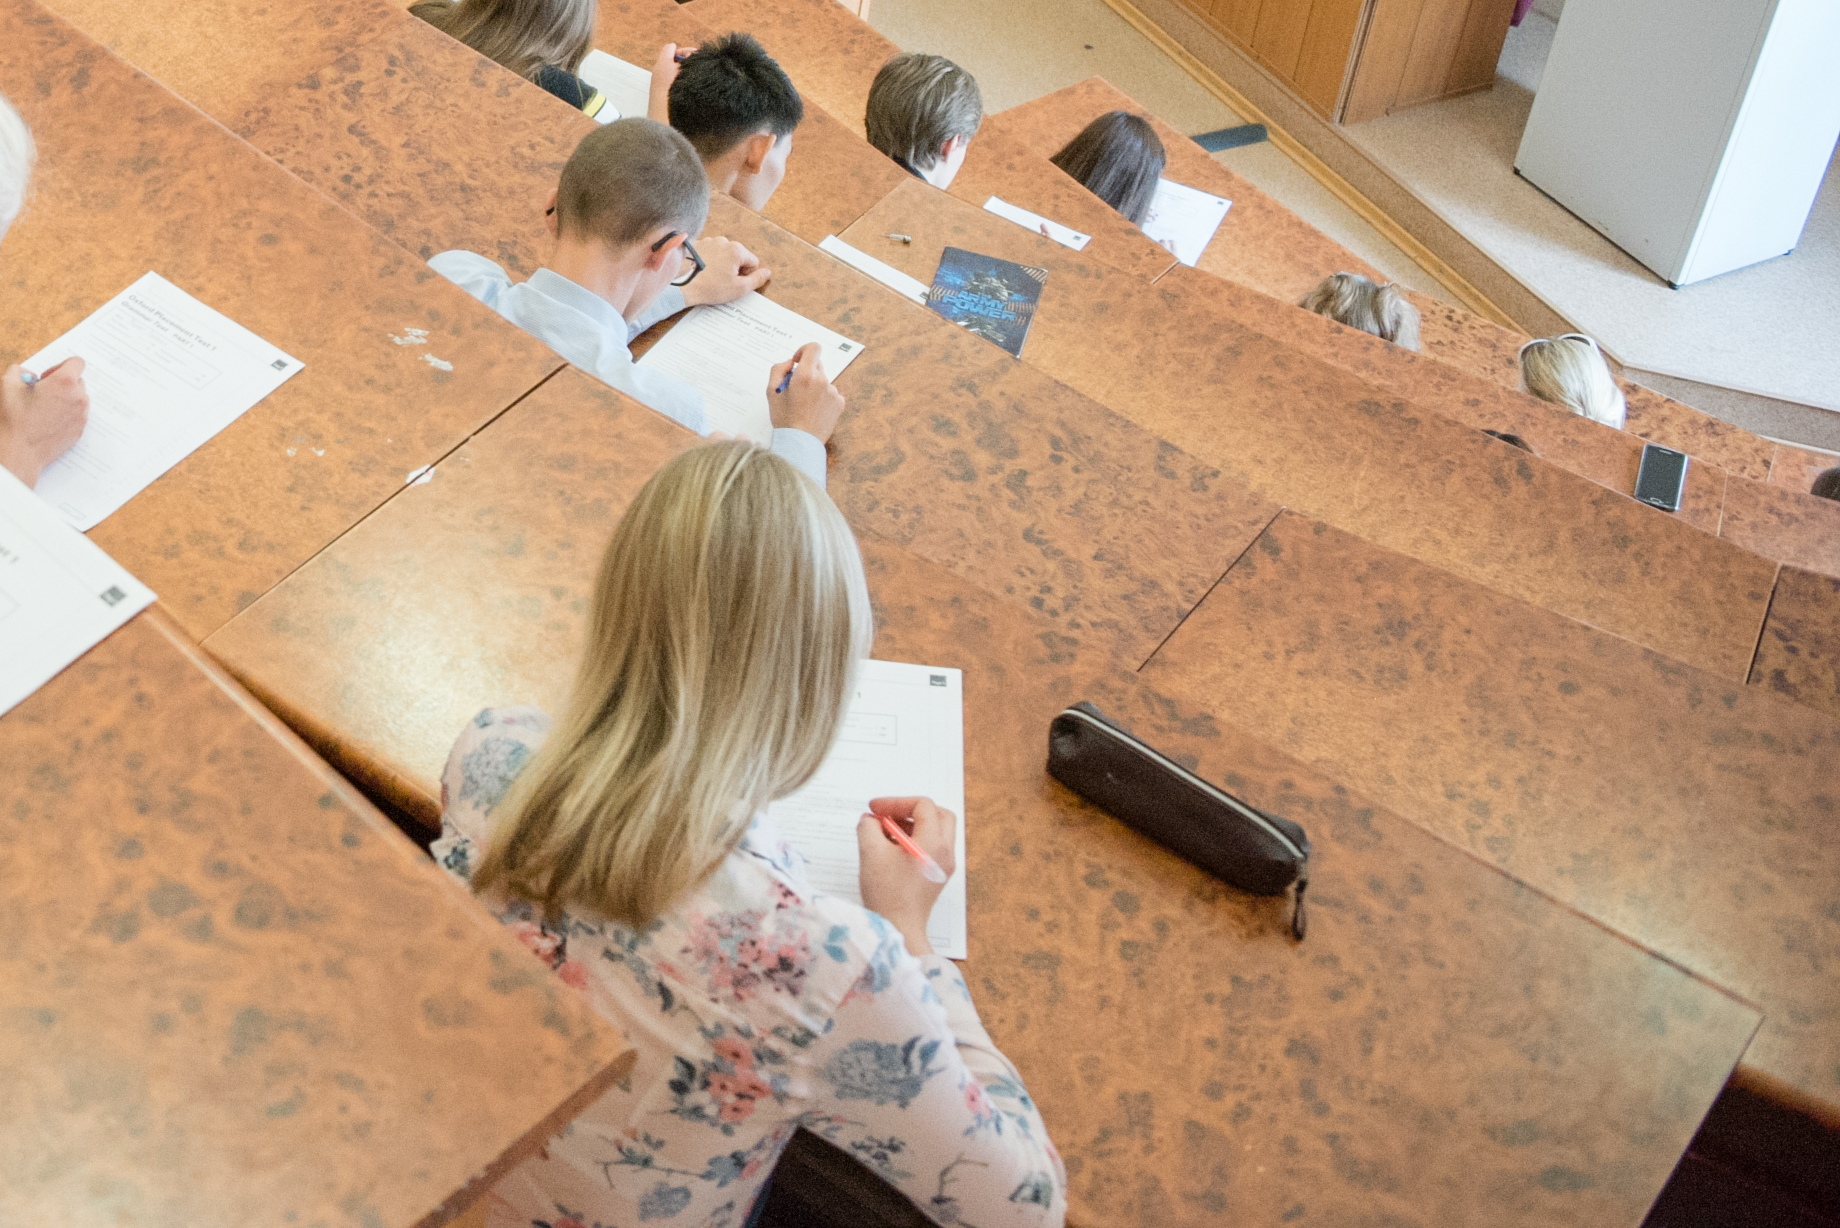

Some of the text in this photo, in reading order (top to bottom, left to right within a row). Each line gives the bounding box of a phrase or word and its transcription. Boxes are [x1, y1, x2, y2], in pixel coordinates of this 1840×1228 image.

[942, 293, 1017, 321] POWER
[957, 290, 1007, 310] ARMY
[121, 300, 152, 322] Grammar
[153, 320, 169, 333] Test
[172, 333, 189, 345] PART
[128, 294, 155, 314] Oxford
[153, 310, 194, 338] Placement
[193, 333, 212, 349] Test
[735, 305, 772, 330] Placement
[772, 326, 789, 338] Test
[736, 316, 751, 327] Test
